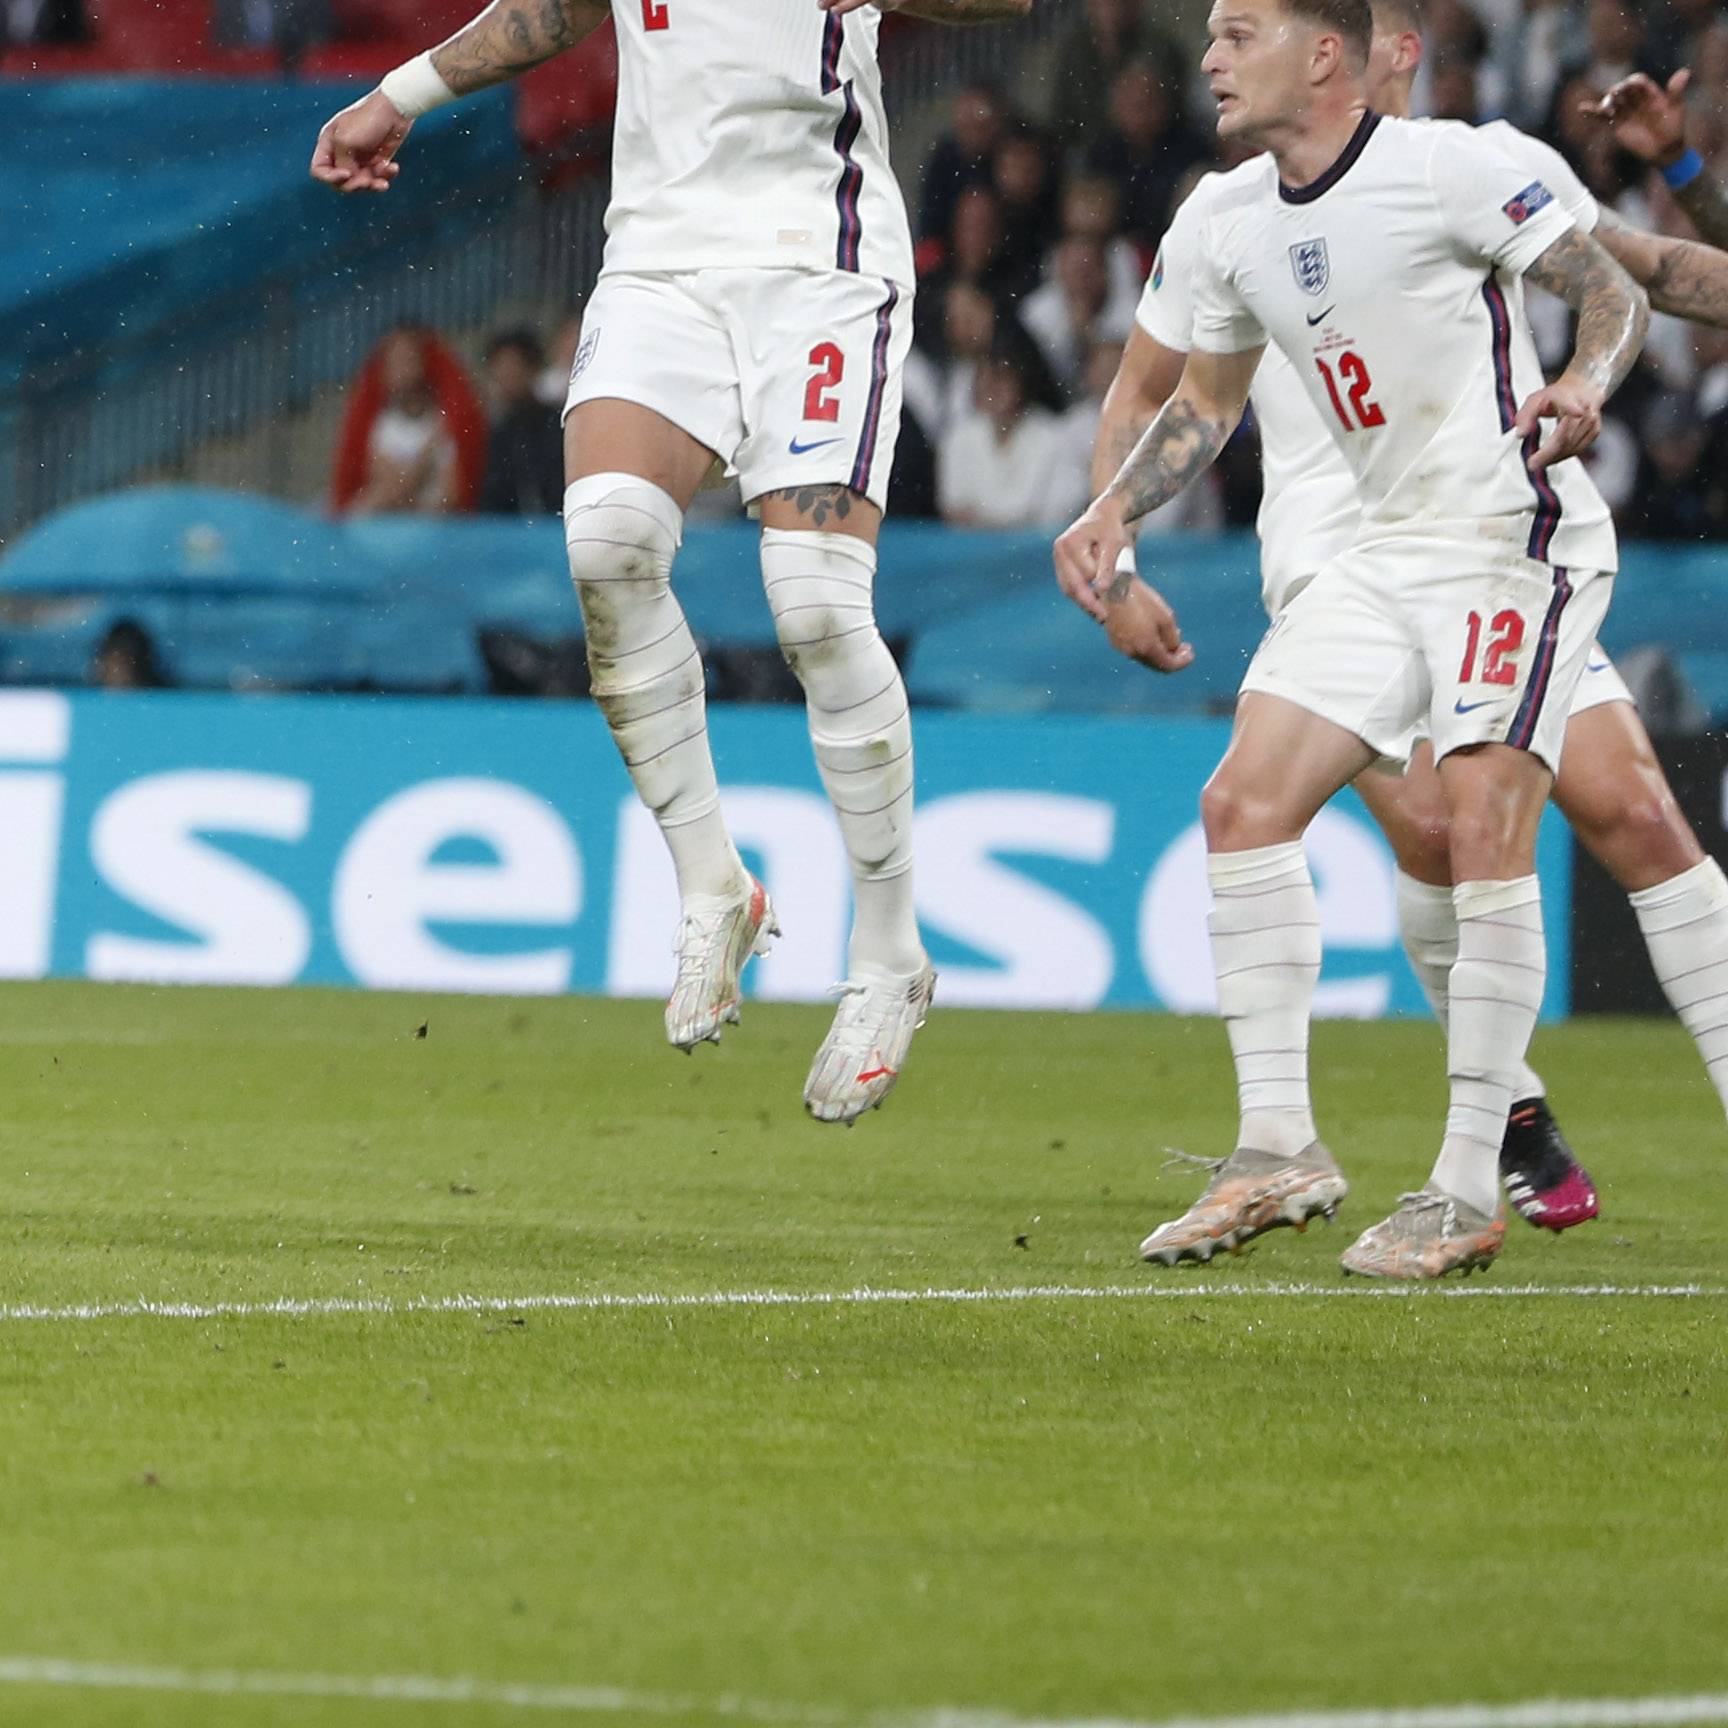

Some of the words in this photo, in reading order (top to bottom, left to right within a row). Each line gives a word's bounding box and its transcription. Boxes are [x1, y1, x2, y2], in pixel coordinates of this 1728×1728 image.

[802, 341, 845, 423] 2
[1315, 351, 1386, 431] 12
[1458, 608, 1525, 688] 12
